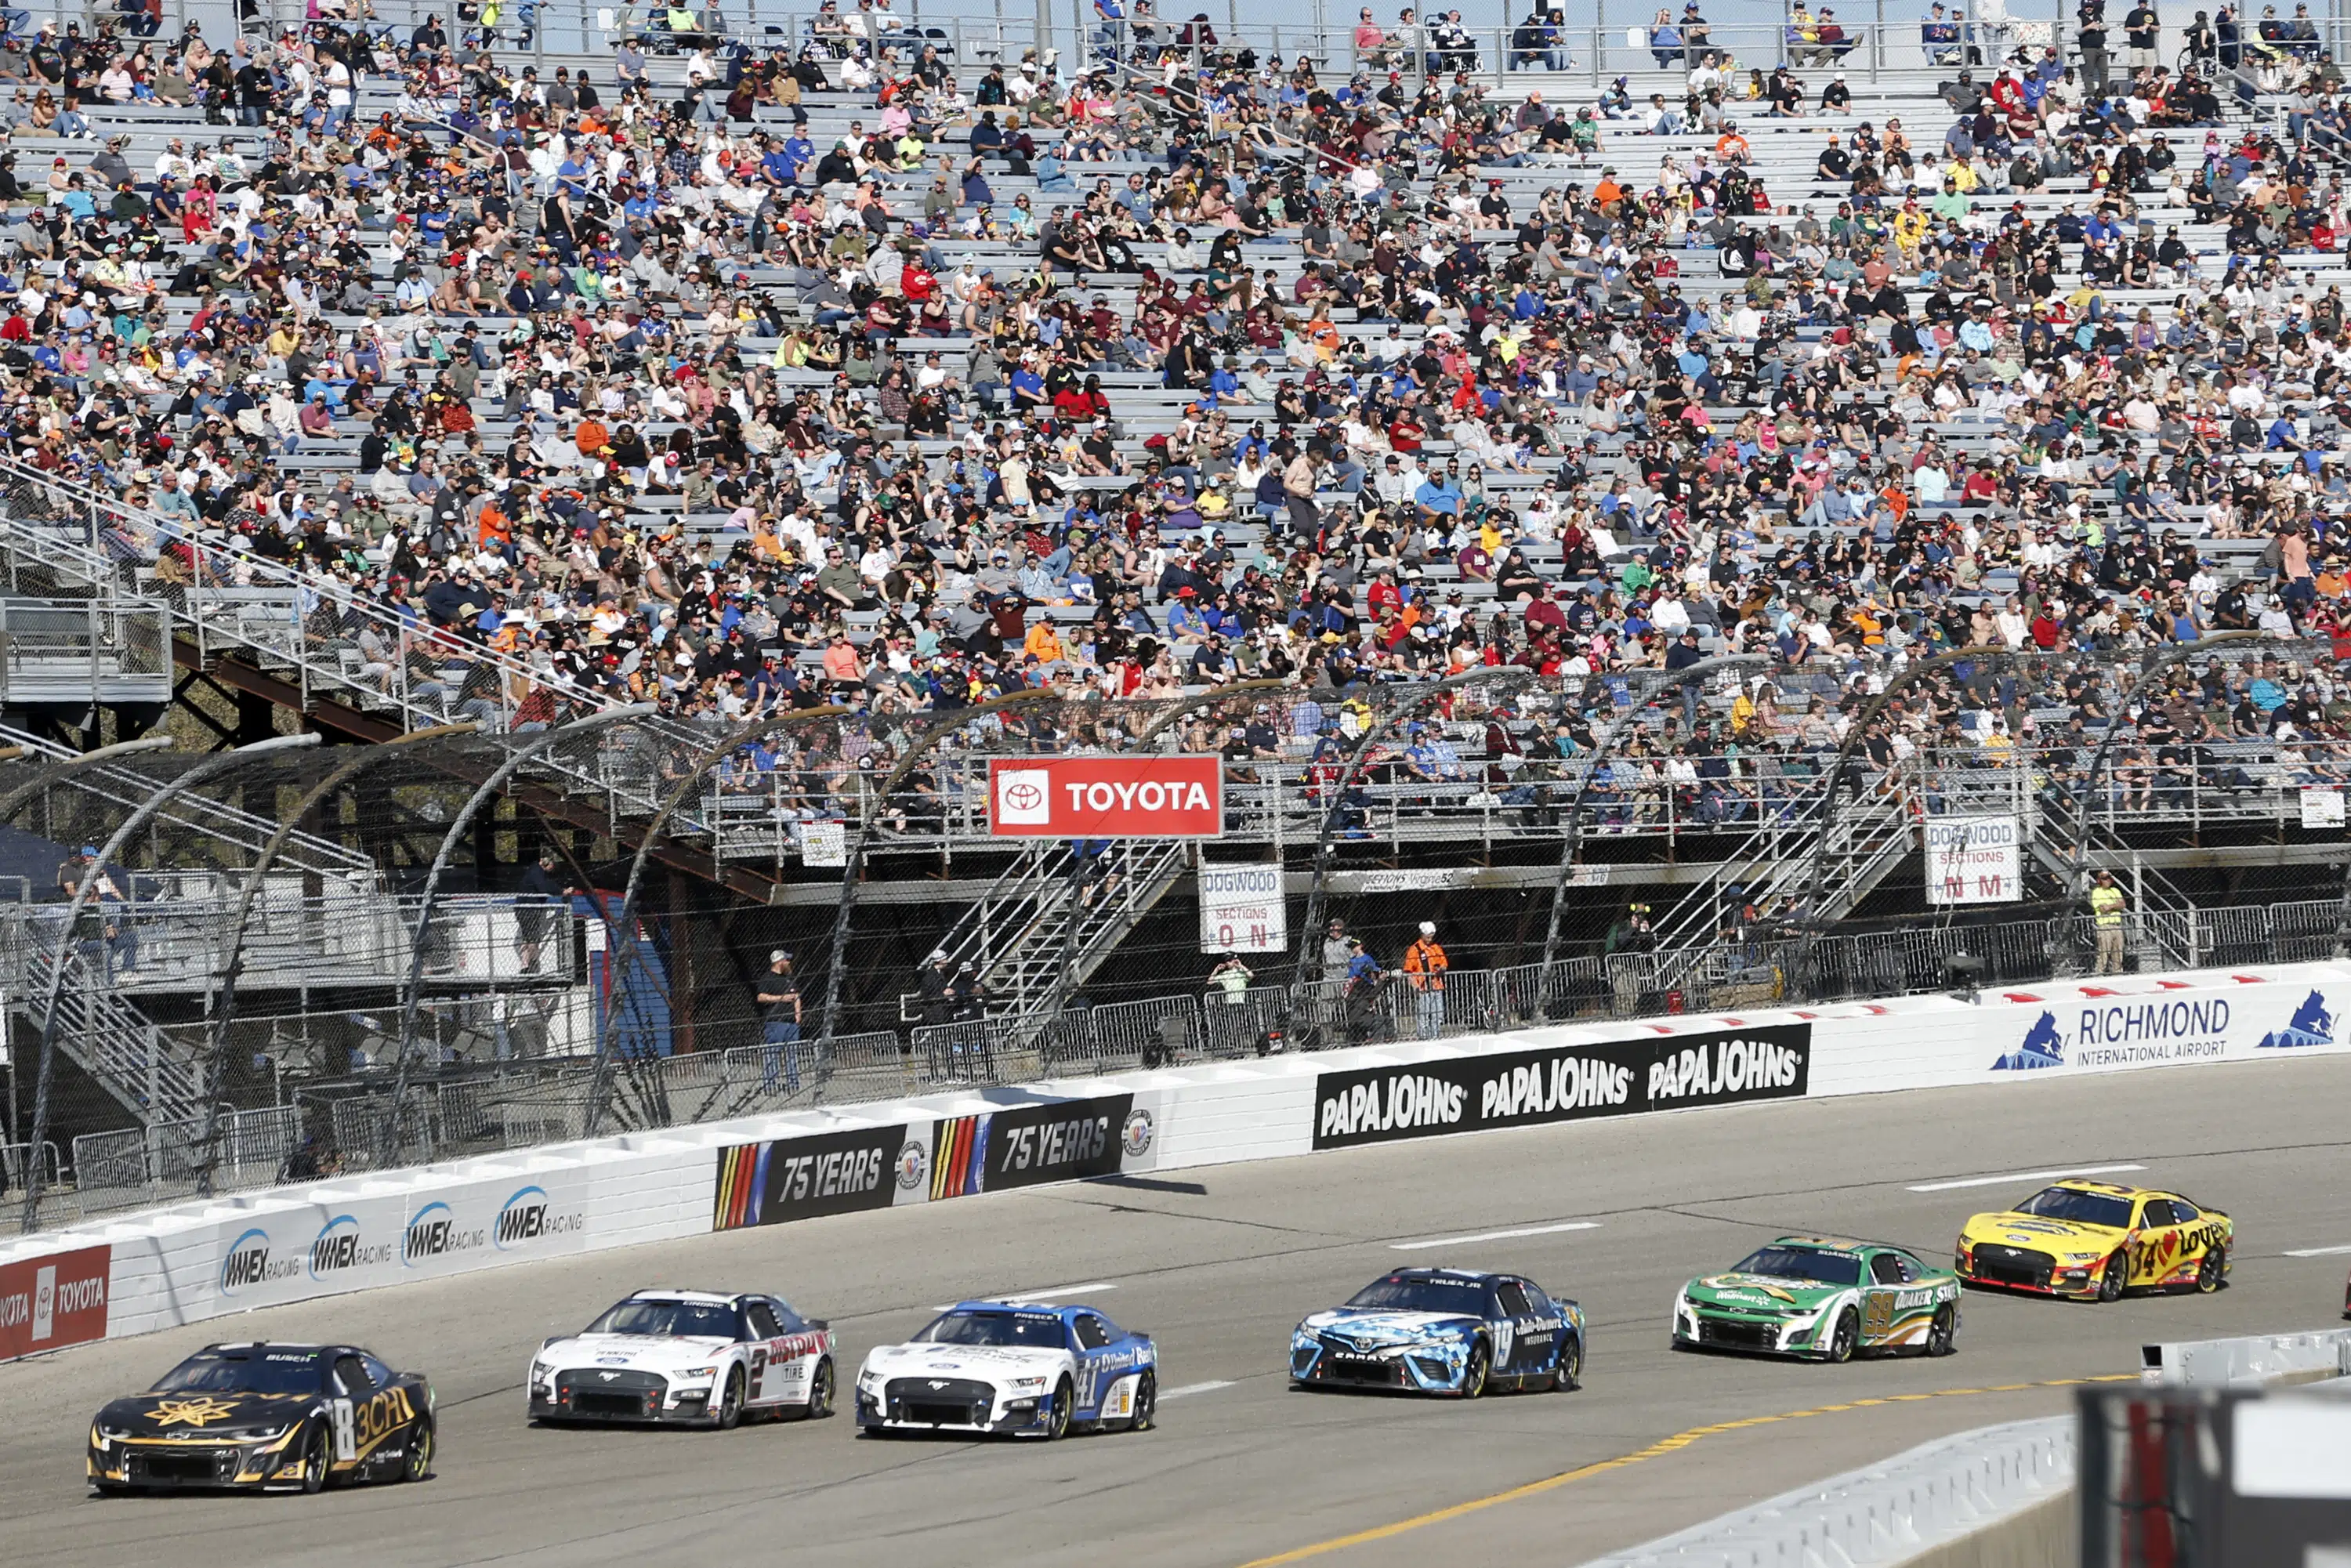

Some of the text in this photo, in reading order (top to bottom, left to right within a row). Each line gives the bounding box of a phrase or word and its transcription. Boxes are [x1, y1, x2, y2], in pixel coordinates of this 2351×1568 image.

[1065, 781, 1211, 812] TOYOTA
[1940, 851, 2005, 864] SECTIONS
[1204, 872, 1277, 892] DOGWOOD
[1945, 874, 2001, 898] N M
[1215, 907, 1268, 920] SECTIONS
[1251, 924, 1266, 947] N
[2079, 999, 2230, 1045] RICHMOND
[1647, 1039, 1797, 1099] PAPA JOHNS
[2078, 1040, 2227, 1067] INTERNATIONAL AIRPORT
[1320, 1074, 1463, 1137] PAPA JOHNS
[1481, 1056, 1628, 1119] PAPA JOHNS
[1001, 1124, 1037, 1172] 75
[1036, 1117, 1109, 1167] YEARS
[778, 1155, 813, 1203] 75
[812, 1147, 883, 1198] YEARS
[2130, 1238, 2160, 1280] 34
[58, 1276, 104, 1314] TOYOTA
[1429, 1278, 1481, 1289] TRUEX JR
[1716, 1291, 1756, 1302] Walmart
[1894, 1288, 1933, 1311] QUAKER
[1863, 1290, 1894, 1338] 99
[1492, 1320, 1514, 1369] 19
[1524, 1334, 1554, 1346] INSURANCE
[747, 1349, 768, 1400] 2
[784, 1367, 805, 1380] TIRE
[1076, 1358, 1100, 1408] 41
[333, 1397, 357, 1461] 8
